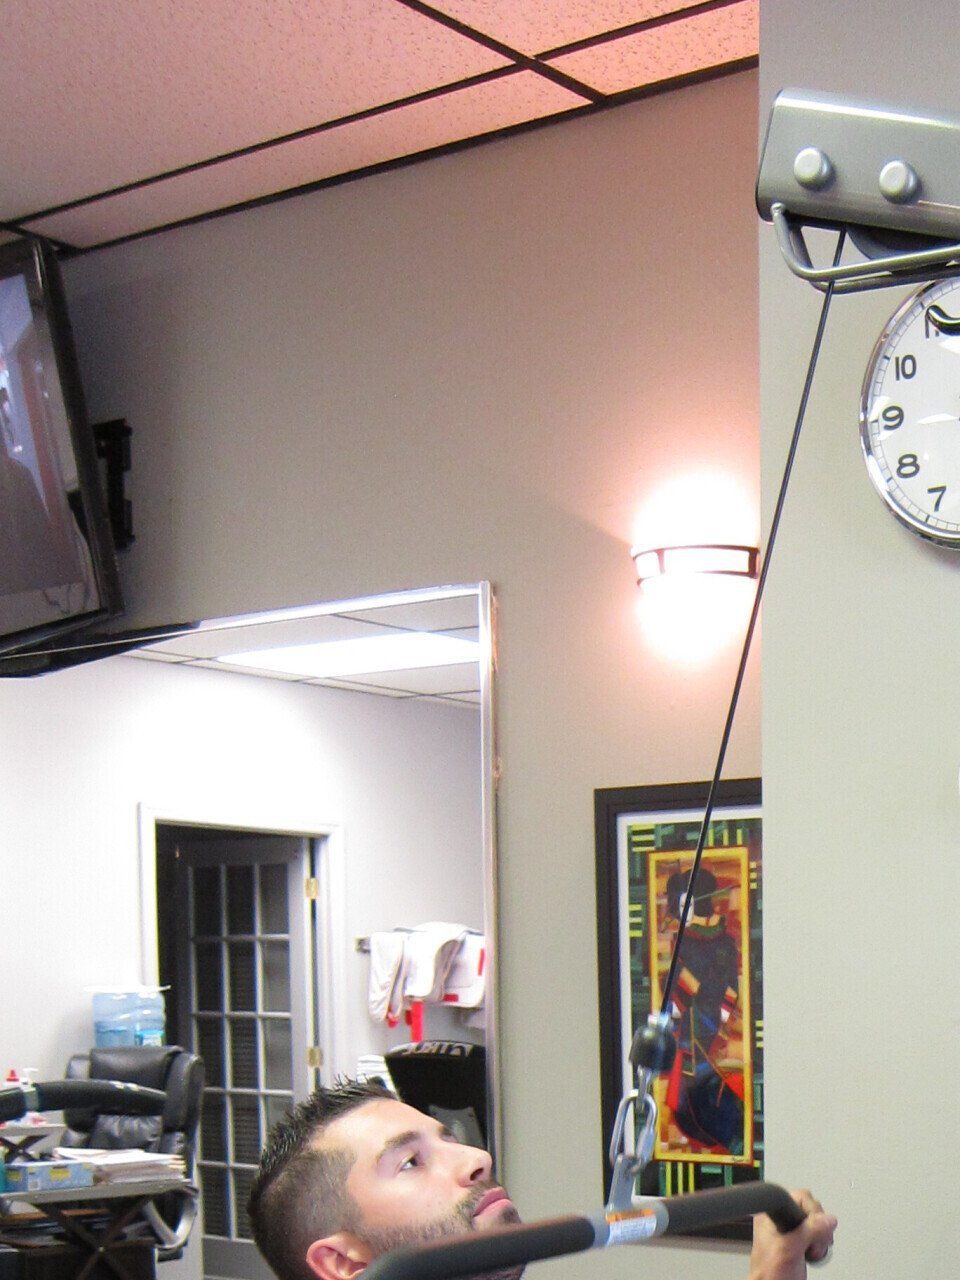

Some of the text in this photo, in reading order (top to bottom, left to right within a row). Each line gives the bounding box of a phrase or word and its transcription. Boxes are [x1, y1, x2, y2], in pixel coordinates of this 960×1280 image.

[895, 355, 917, 381] 10
[882, 405, 904, 430] 9
[896, 453, 920, 478] 8
[927, 486, 947, 512] 7
